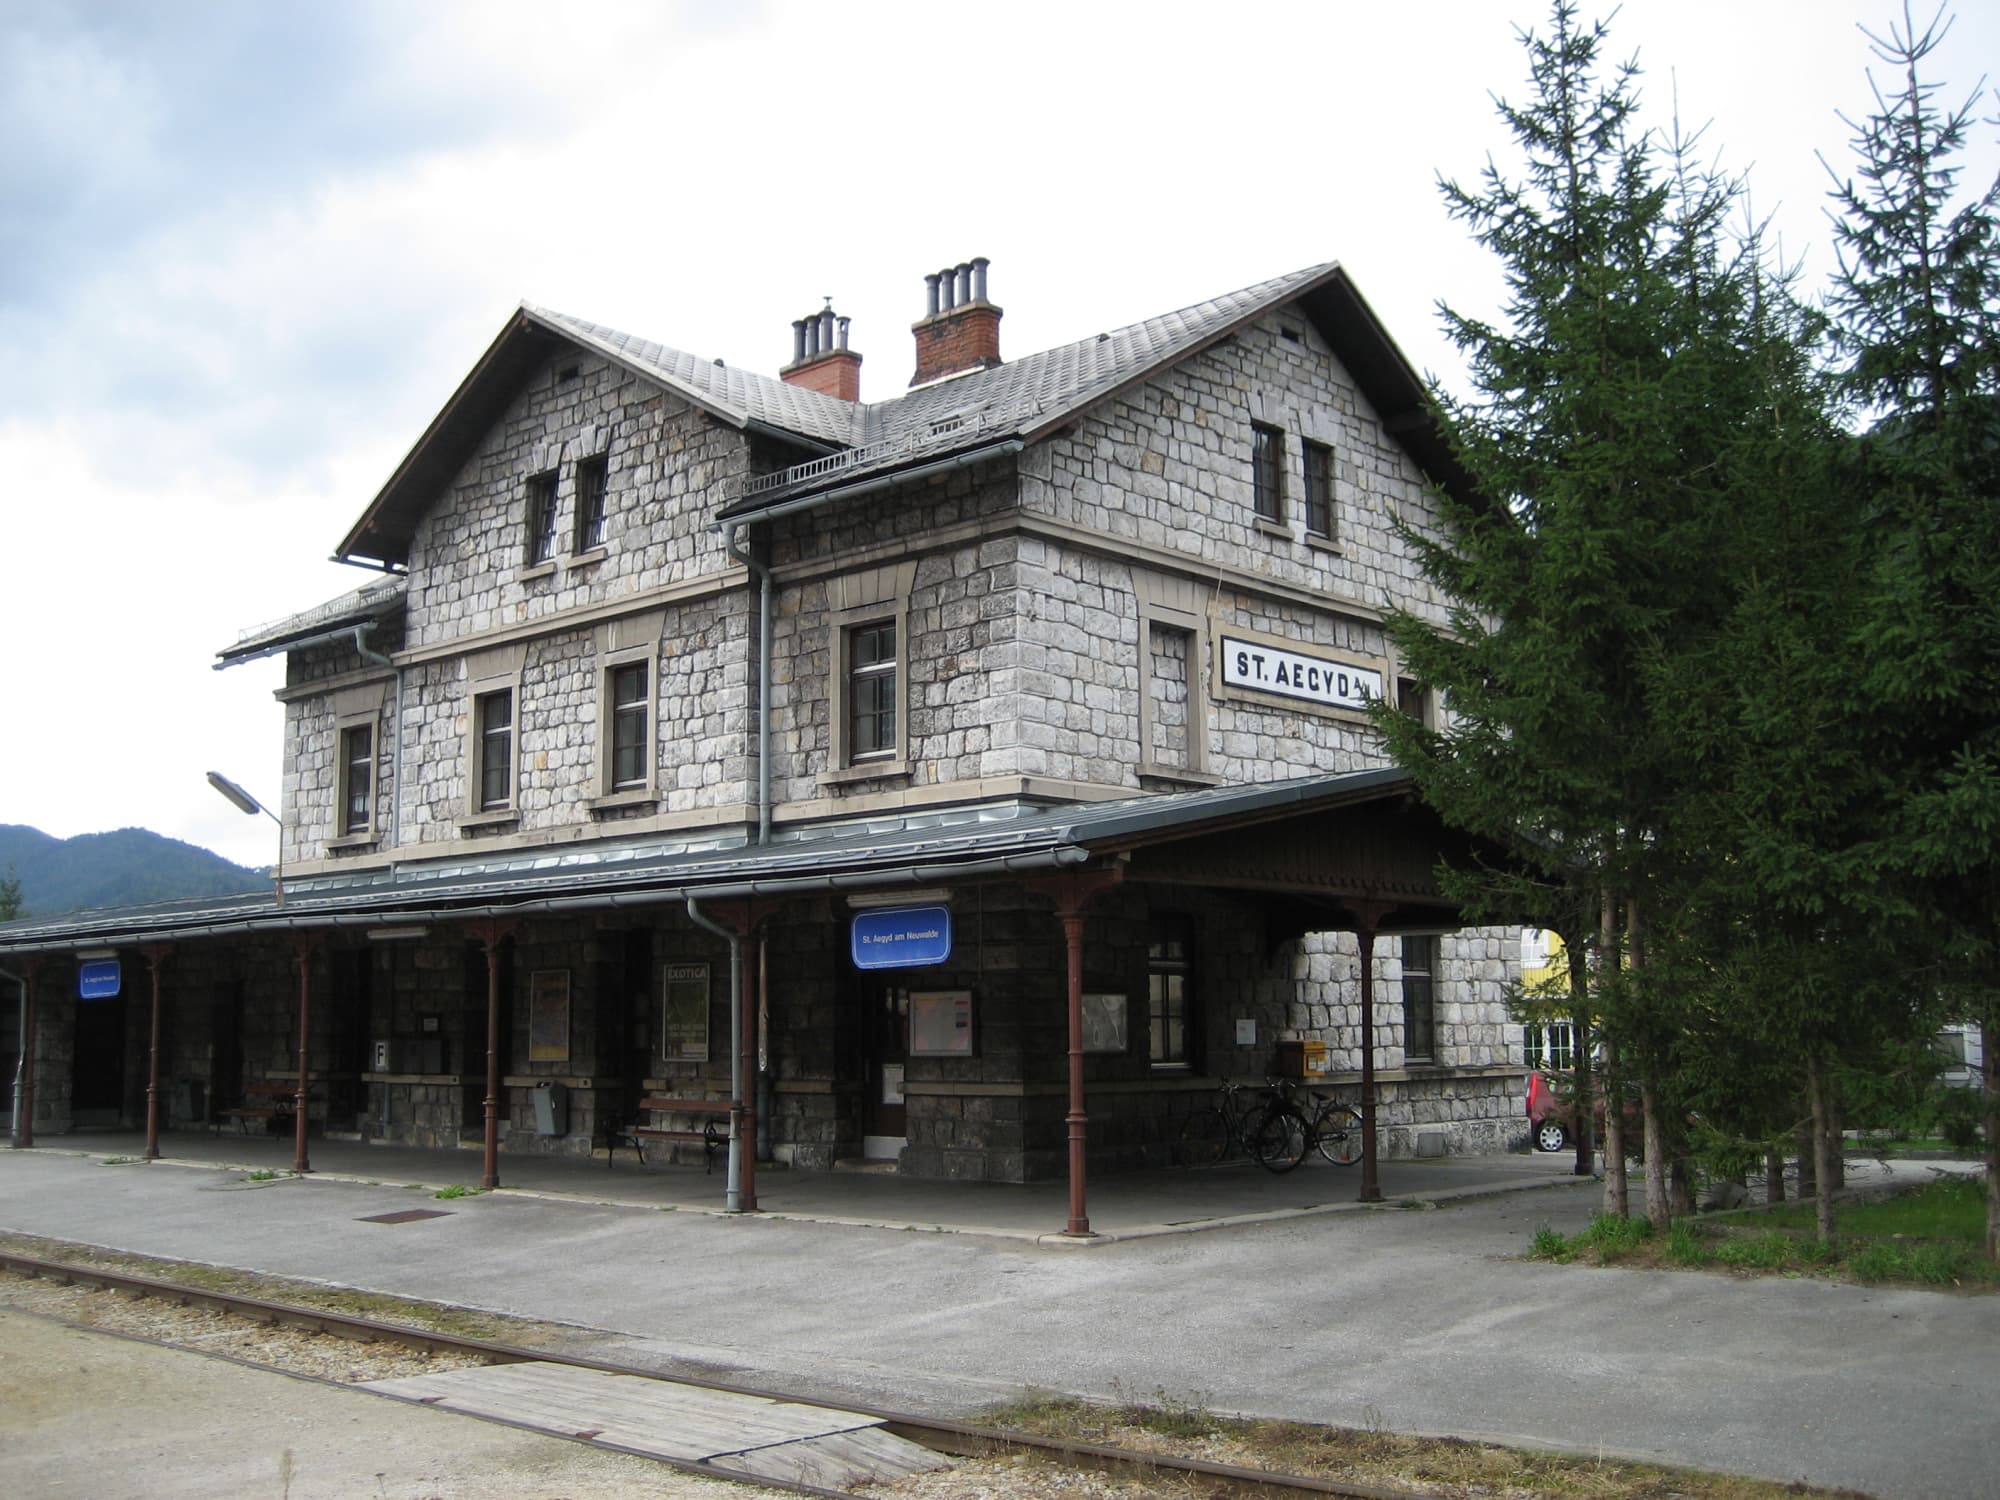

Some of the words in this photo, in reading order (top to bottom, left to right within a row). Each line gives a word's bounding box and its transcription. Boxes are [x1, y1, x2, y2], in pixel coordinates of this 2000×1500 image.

[1237, 651, 1268, 681] ST.
[862, 935, 872, 944] St.
[894, 933, 905, 941] am
[667, 967, 706, 979] EXOTICA
[377, 1044, 385, 1065] F
